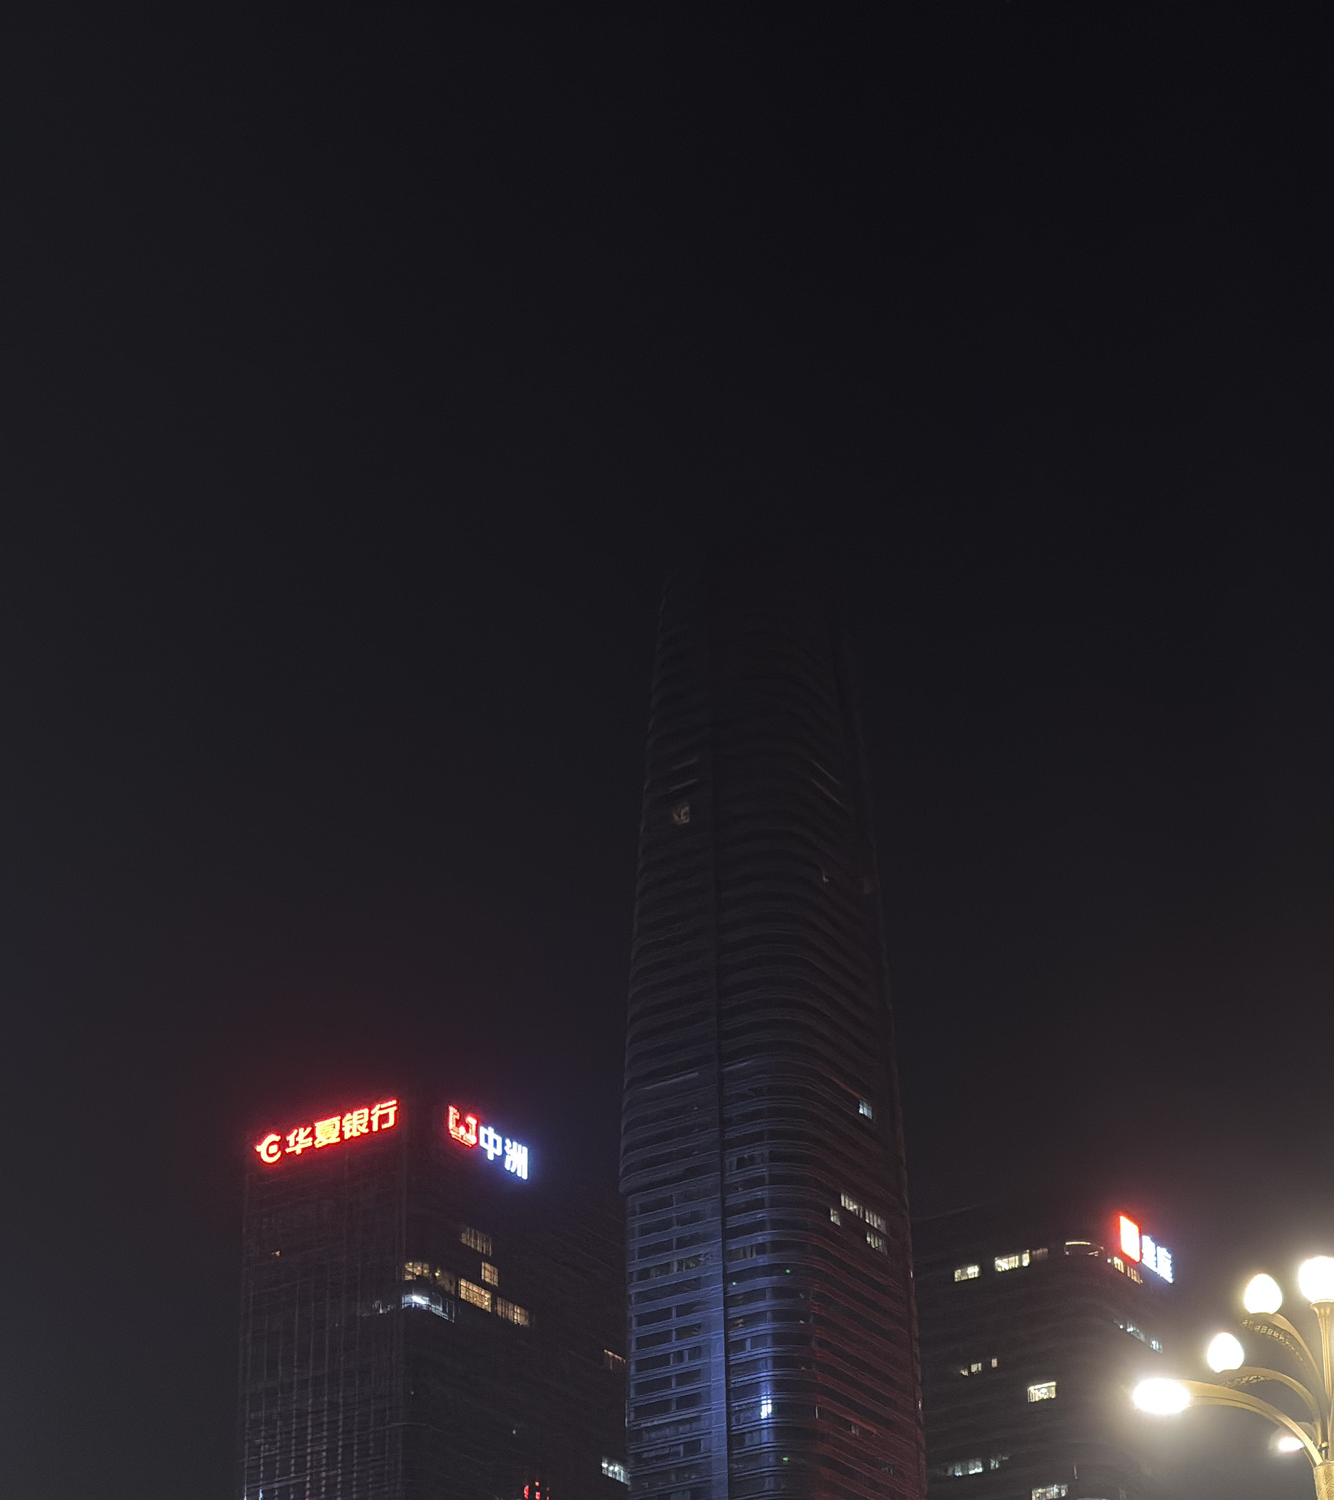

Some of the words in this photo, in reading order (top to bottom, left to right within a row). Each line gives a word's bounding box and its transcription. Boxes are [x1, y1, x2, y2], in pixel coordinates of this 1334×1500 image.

[285, 1099, 398, 1154] 华夏银行
[479, 1126, 528, 1180] 中洲
